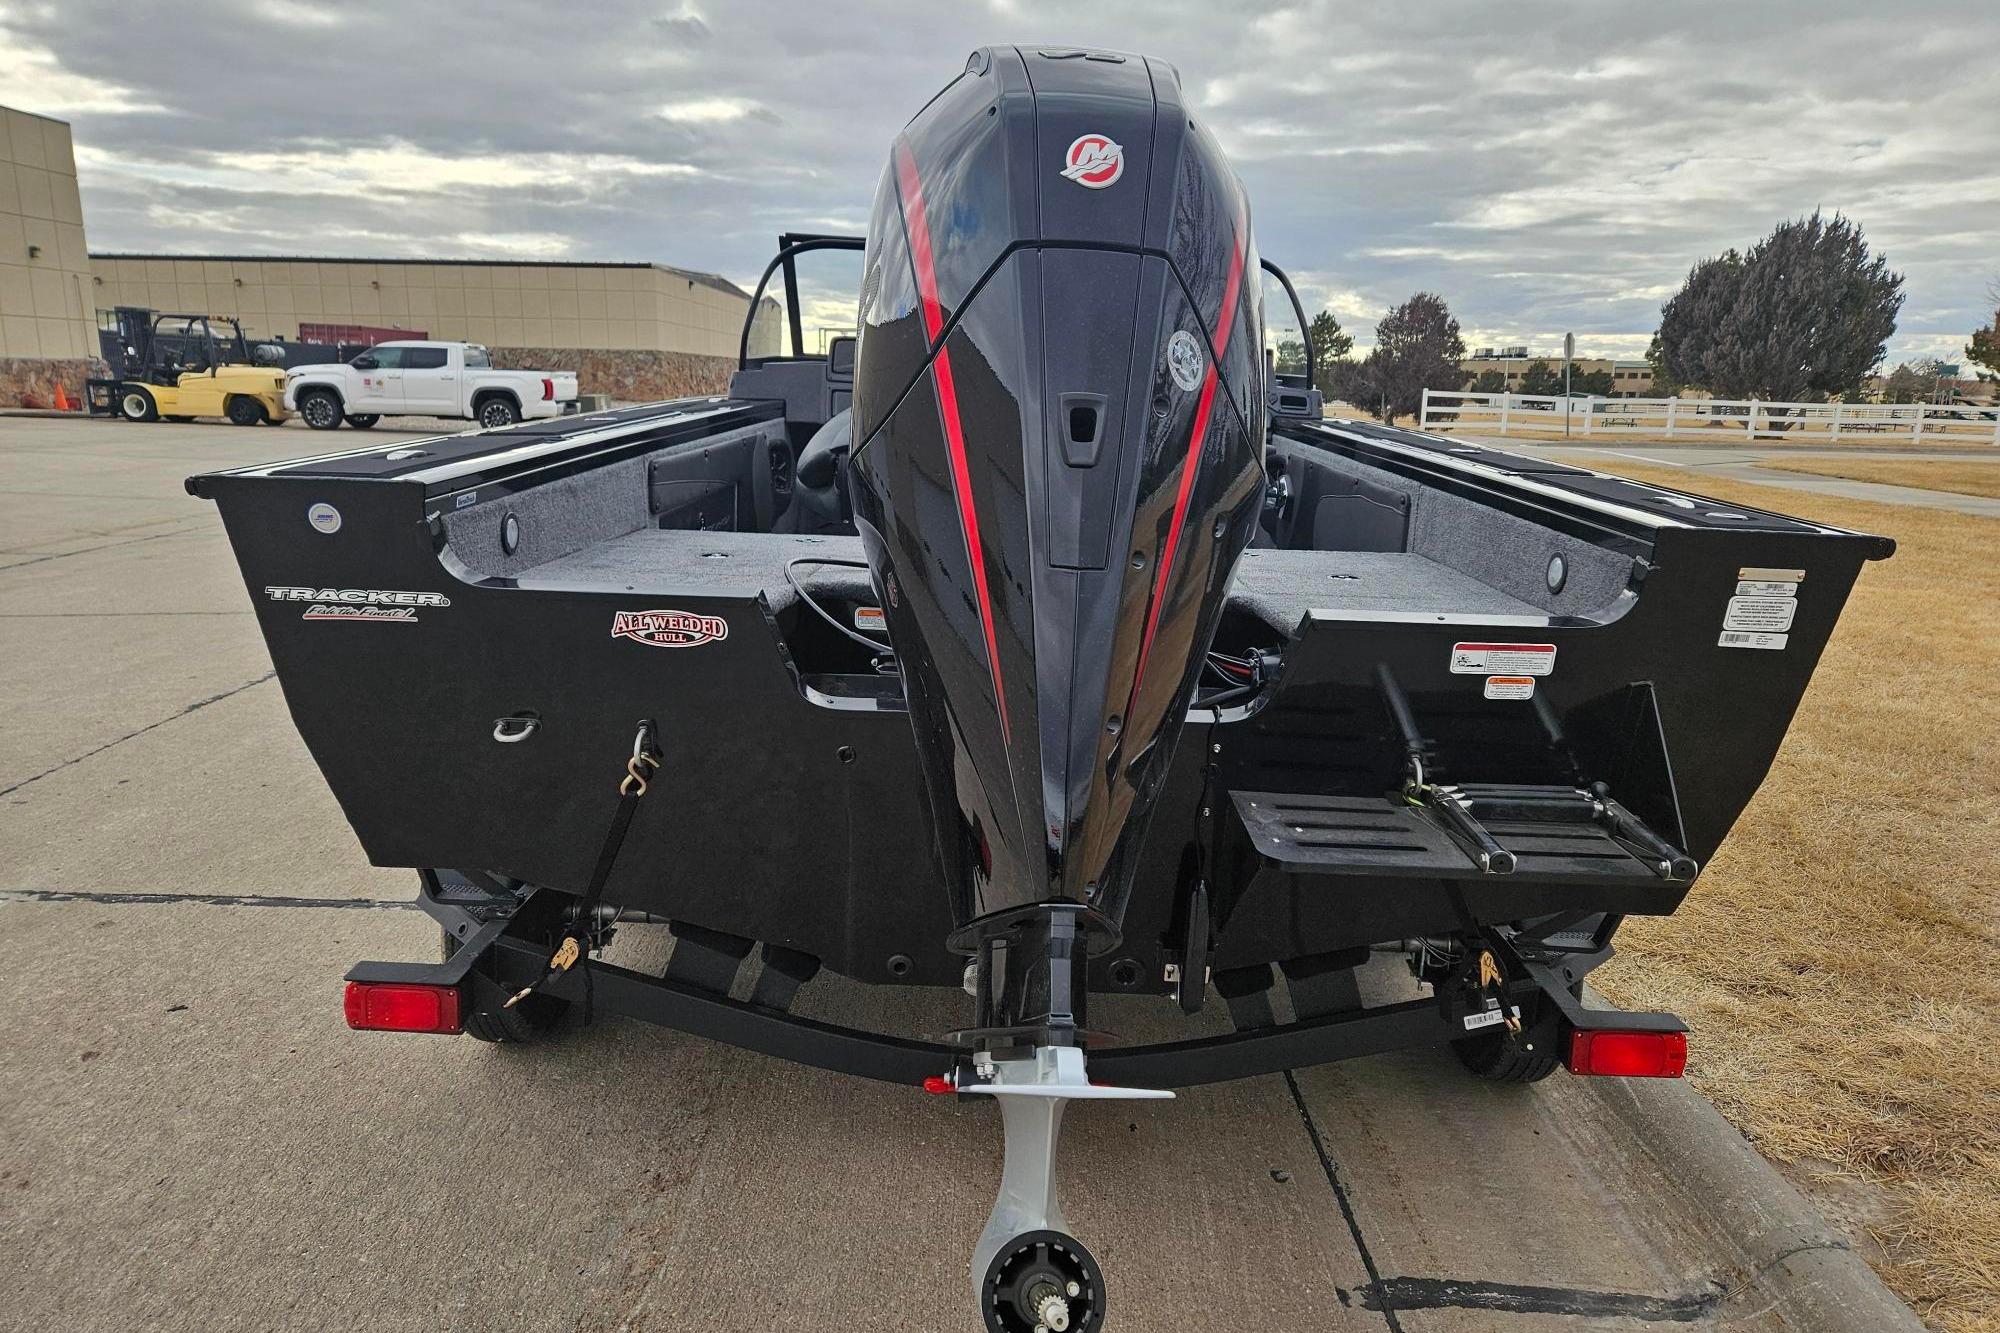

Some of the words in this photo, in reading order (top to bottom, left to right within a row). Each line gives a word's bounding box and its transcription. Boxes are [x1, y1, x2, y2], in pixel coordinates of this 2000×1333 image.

[307, 605, 336, 616] Fish
[338, 606, 357, 616] the
[614, 613, 649, 634] ALL
[651, 615, 725, 637] WELDED
[653, 632, 687, 643] HULL
